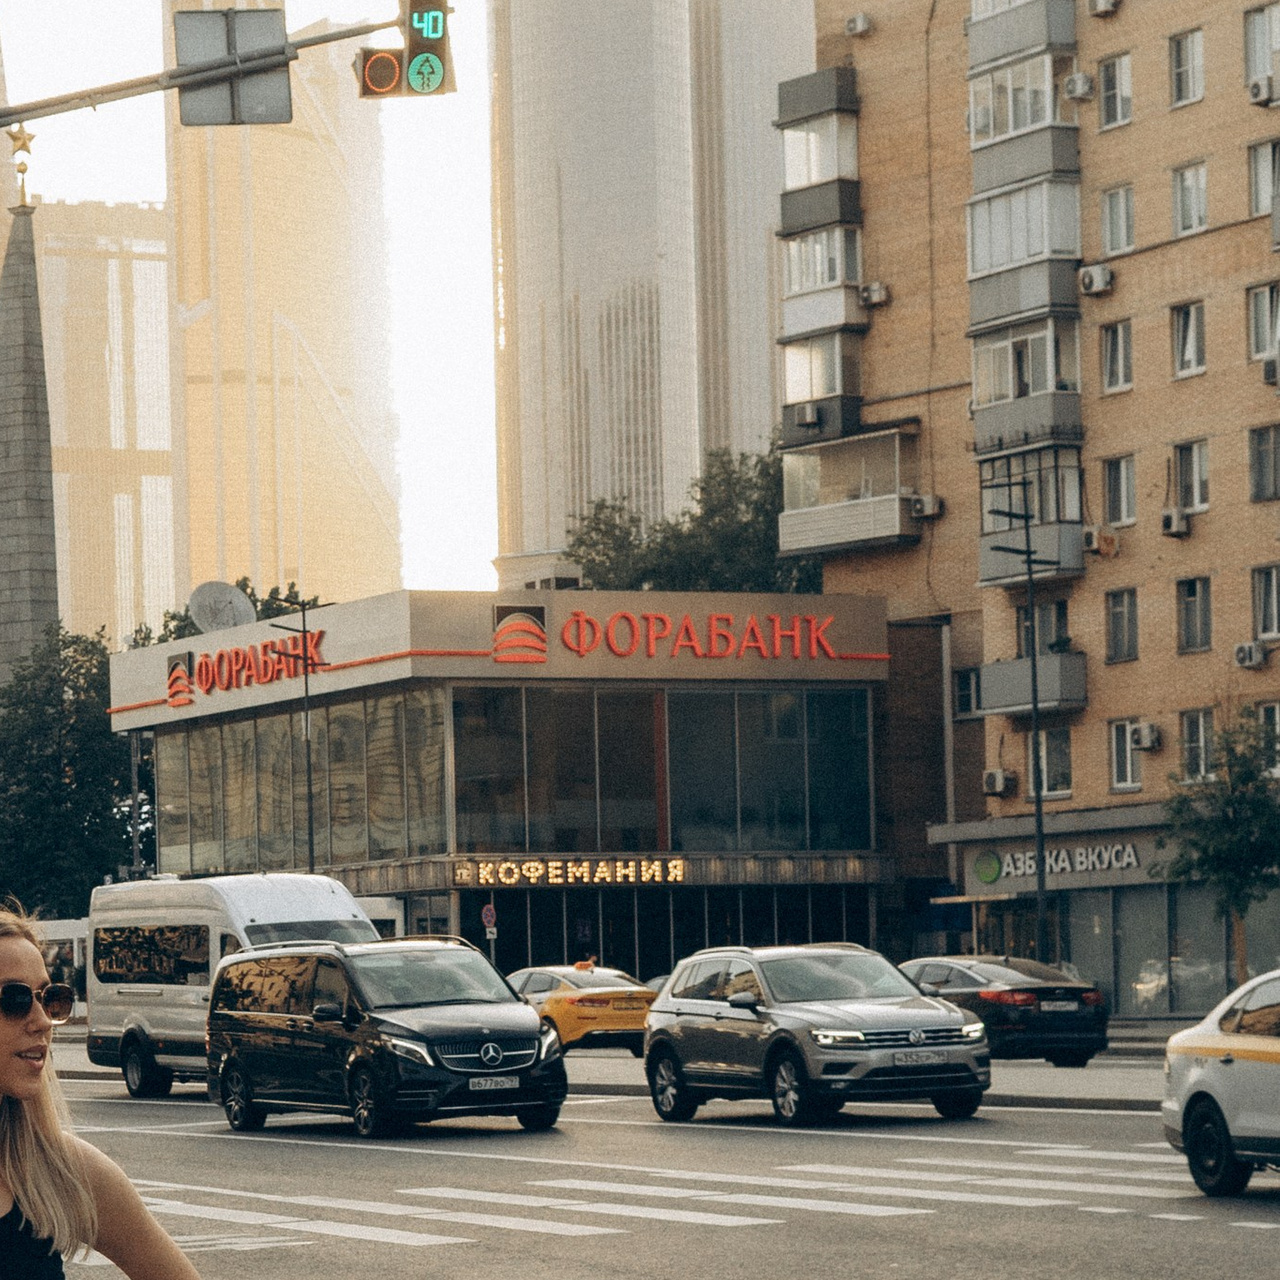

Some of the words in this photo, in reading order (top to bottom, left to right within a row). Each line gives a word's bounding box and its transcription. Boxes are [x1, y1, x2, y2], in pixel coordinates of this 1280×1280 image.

[412, 10, 444, 39] 40
[562, 610, 837, 659] ФОРАБАНК
[195, 629, 326, 695] ФОРАБАНК
[478, 860, 684, 885] КОФЕМАНИЯ
[1001, 848, 1072, 878] АЗБКА
[1075, 843, 1139, 871] ВКУСА
